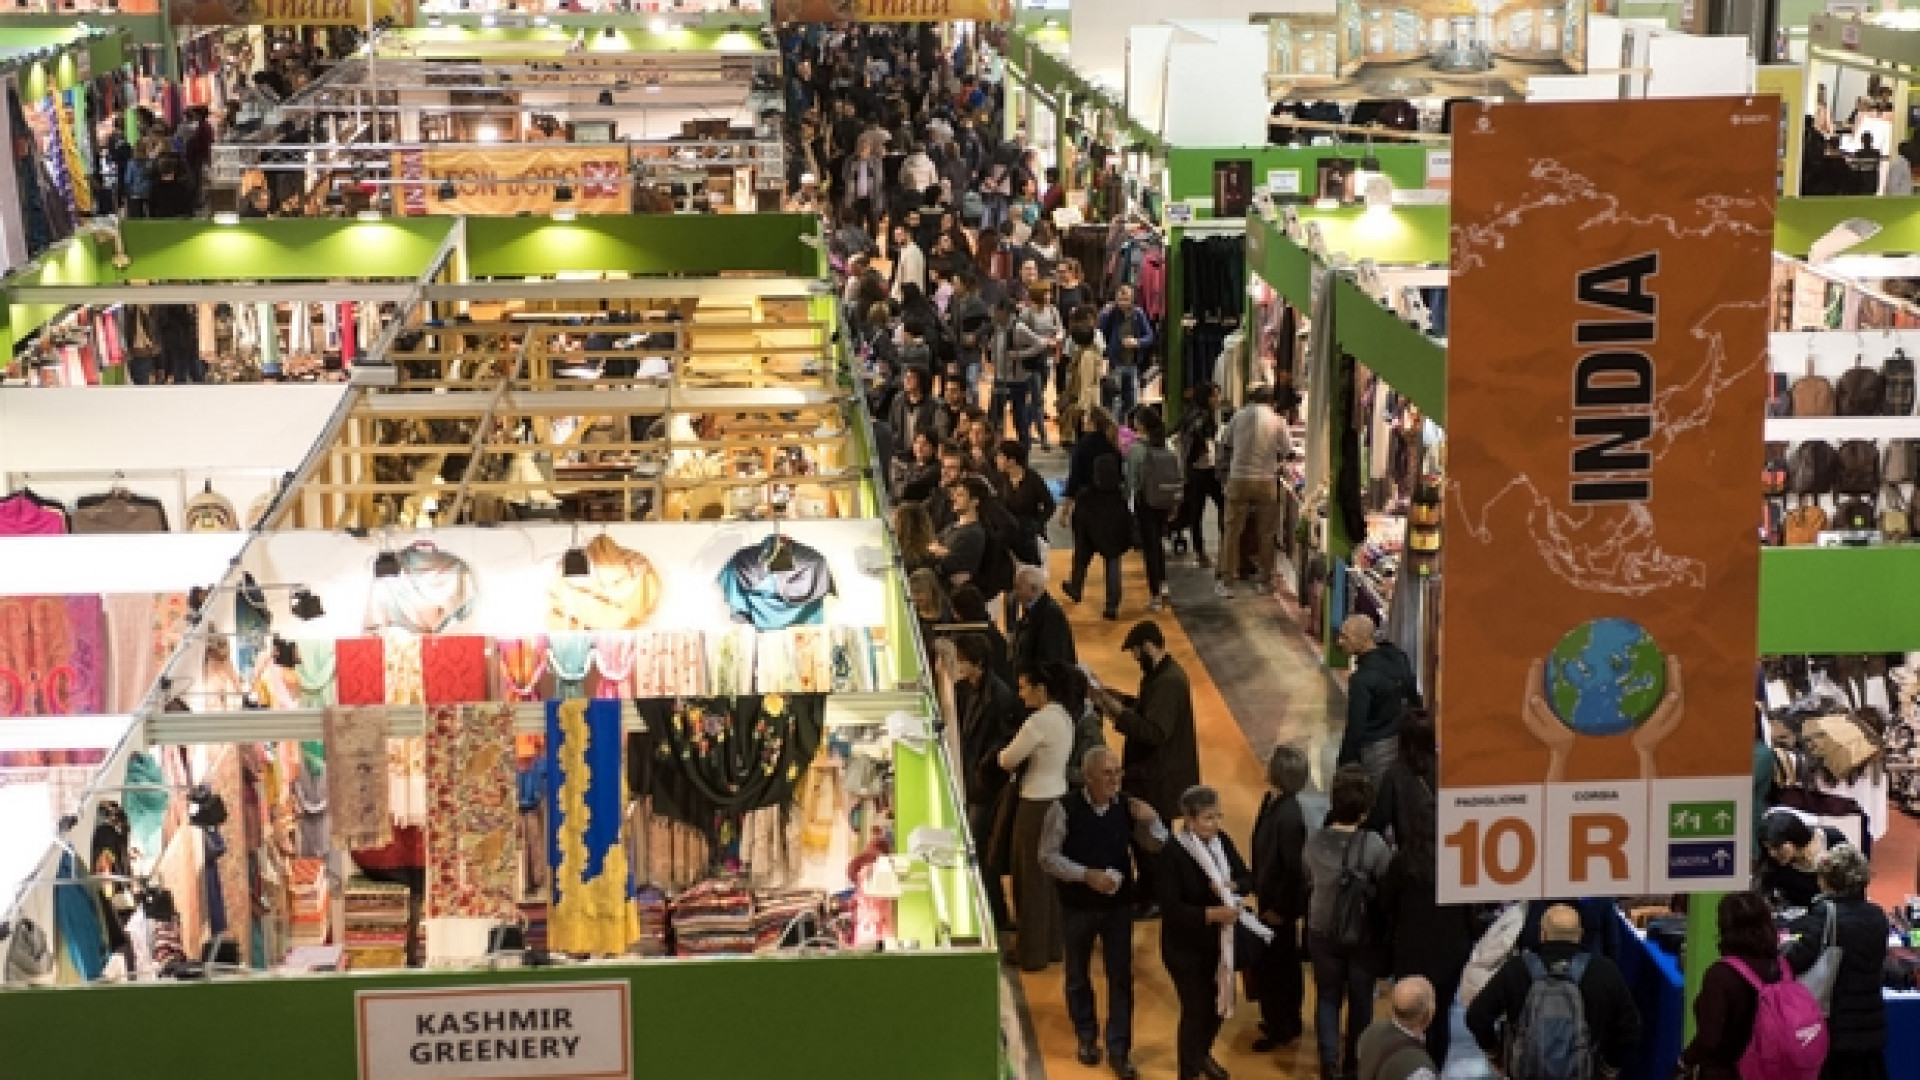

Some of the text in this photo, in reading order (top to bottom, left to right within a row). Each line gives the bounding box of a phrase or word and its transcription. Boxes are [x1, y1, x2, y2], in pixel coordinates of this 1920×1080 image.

[1569, 249, 1660, 506] INDIA
[1444, 815, 1537, 888] 10
[1569, 812, 1631, 882] R
[409, 1034, 582, 1065] GREENERY
[415, 1007, 573, 1036] KASHMIR
